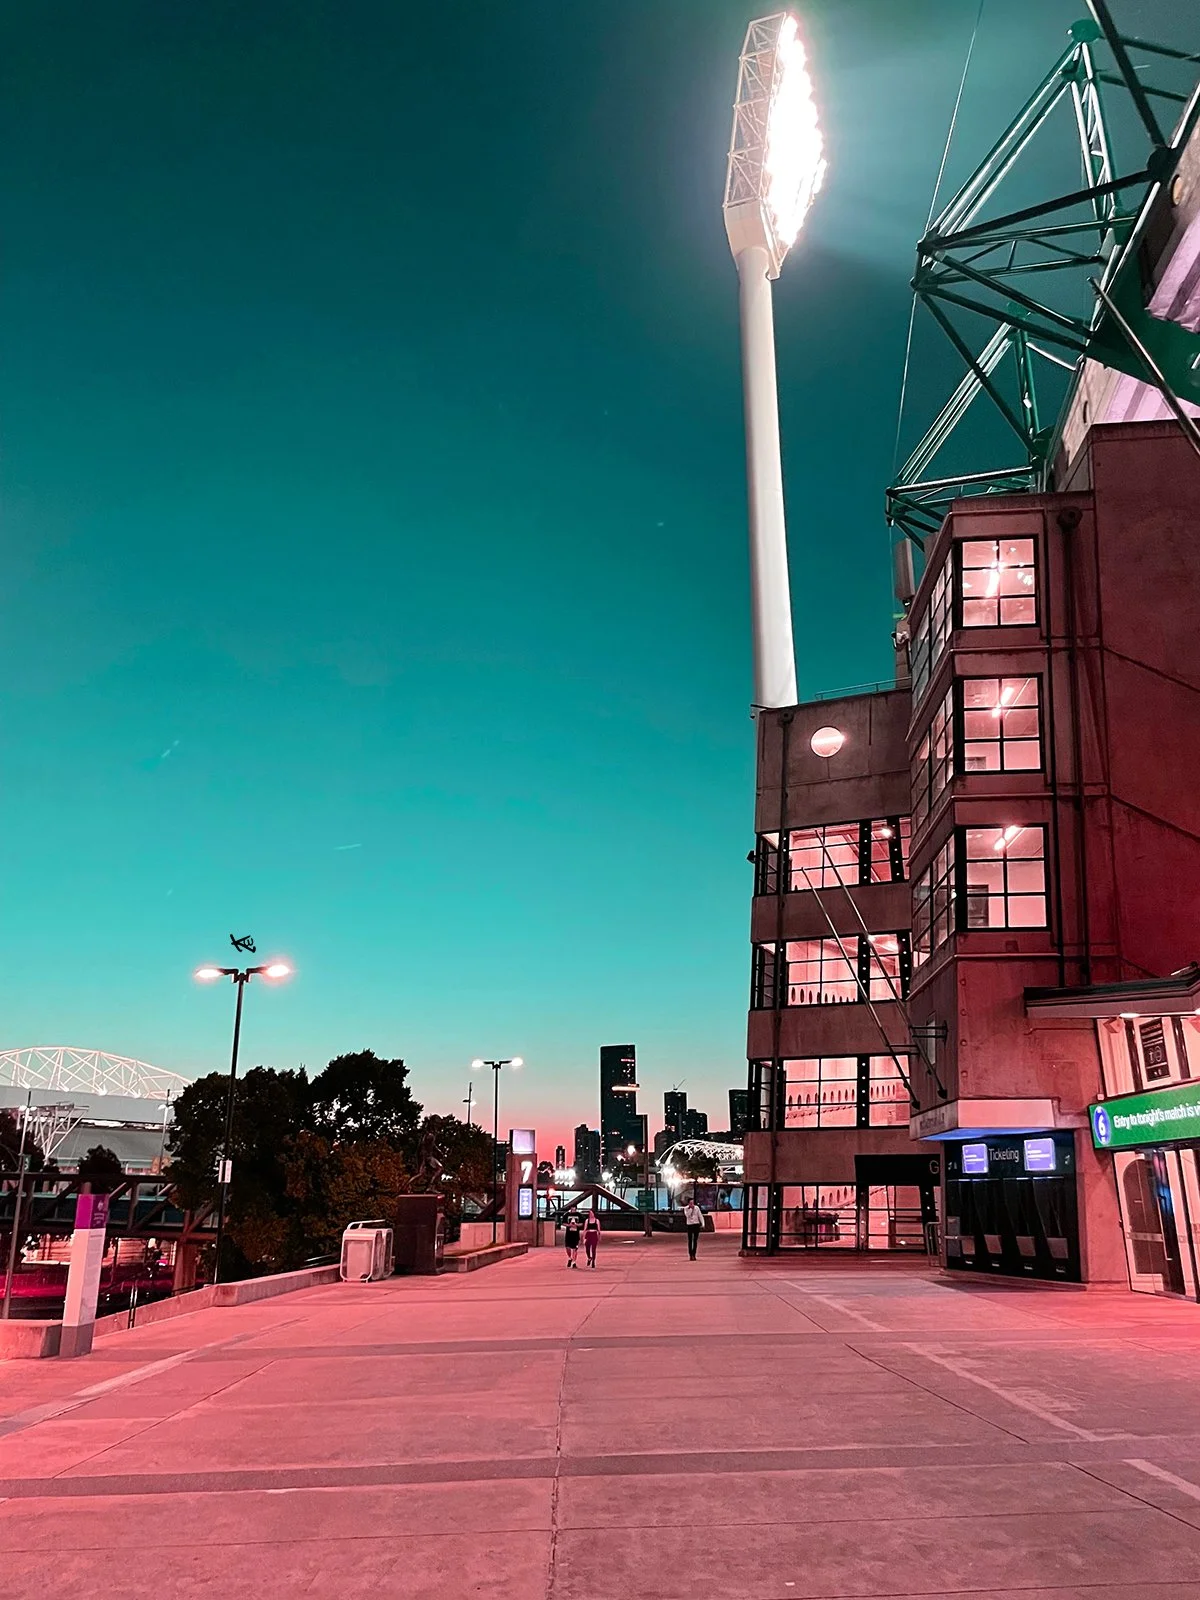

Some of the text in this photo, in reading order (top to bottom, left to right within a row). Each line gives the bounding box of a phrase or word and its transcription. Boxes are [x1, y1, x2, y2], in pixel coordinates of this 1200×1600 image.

[1098, 1114, 1106, 1136] 6
[1113, 1115, 1130, 1130] Entry
[1129, 1113, 1138, 1125] to
[1137, 1108, 1165, 1127] tonight's
[1164, 1103, 1187, 1120] match
[1185, 1102, 1194, 1117] is
[988, 1147, 1020, 1163] Ticketing
[521, 1161, 533, 1184] 7
